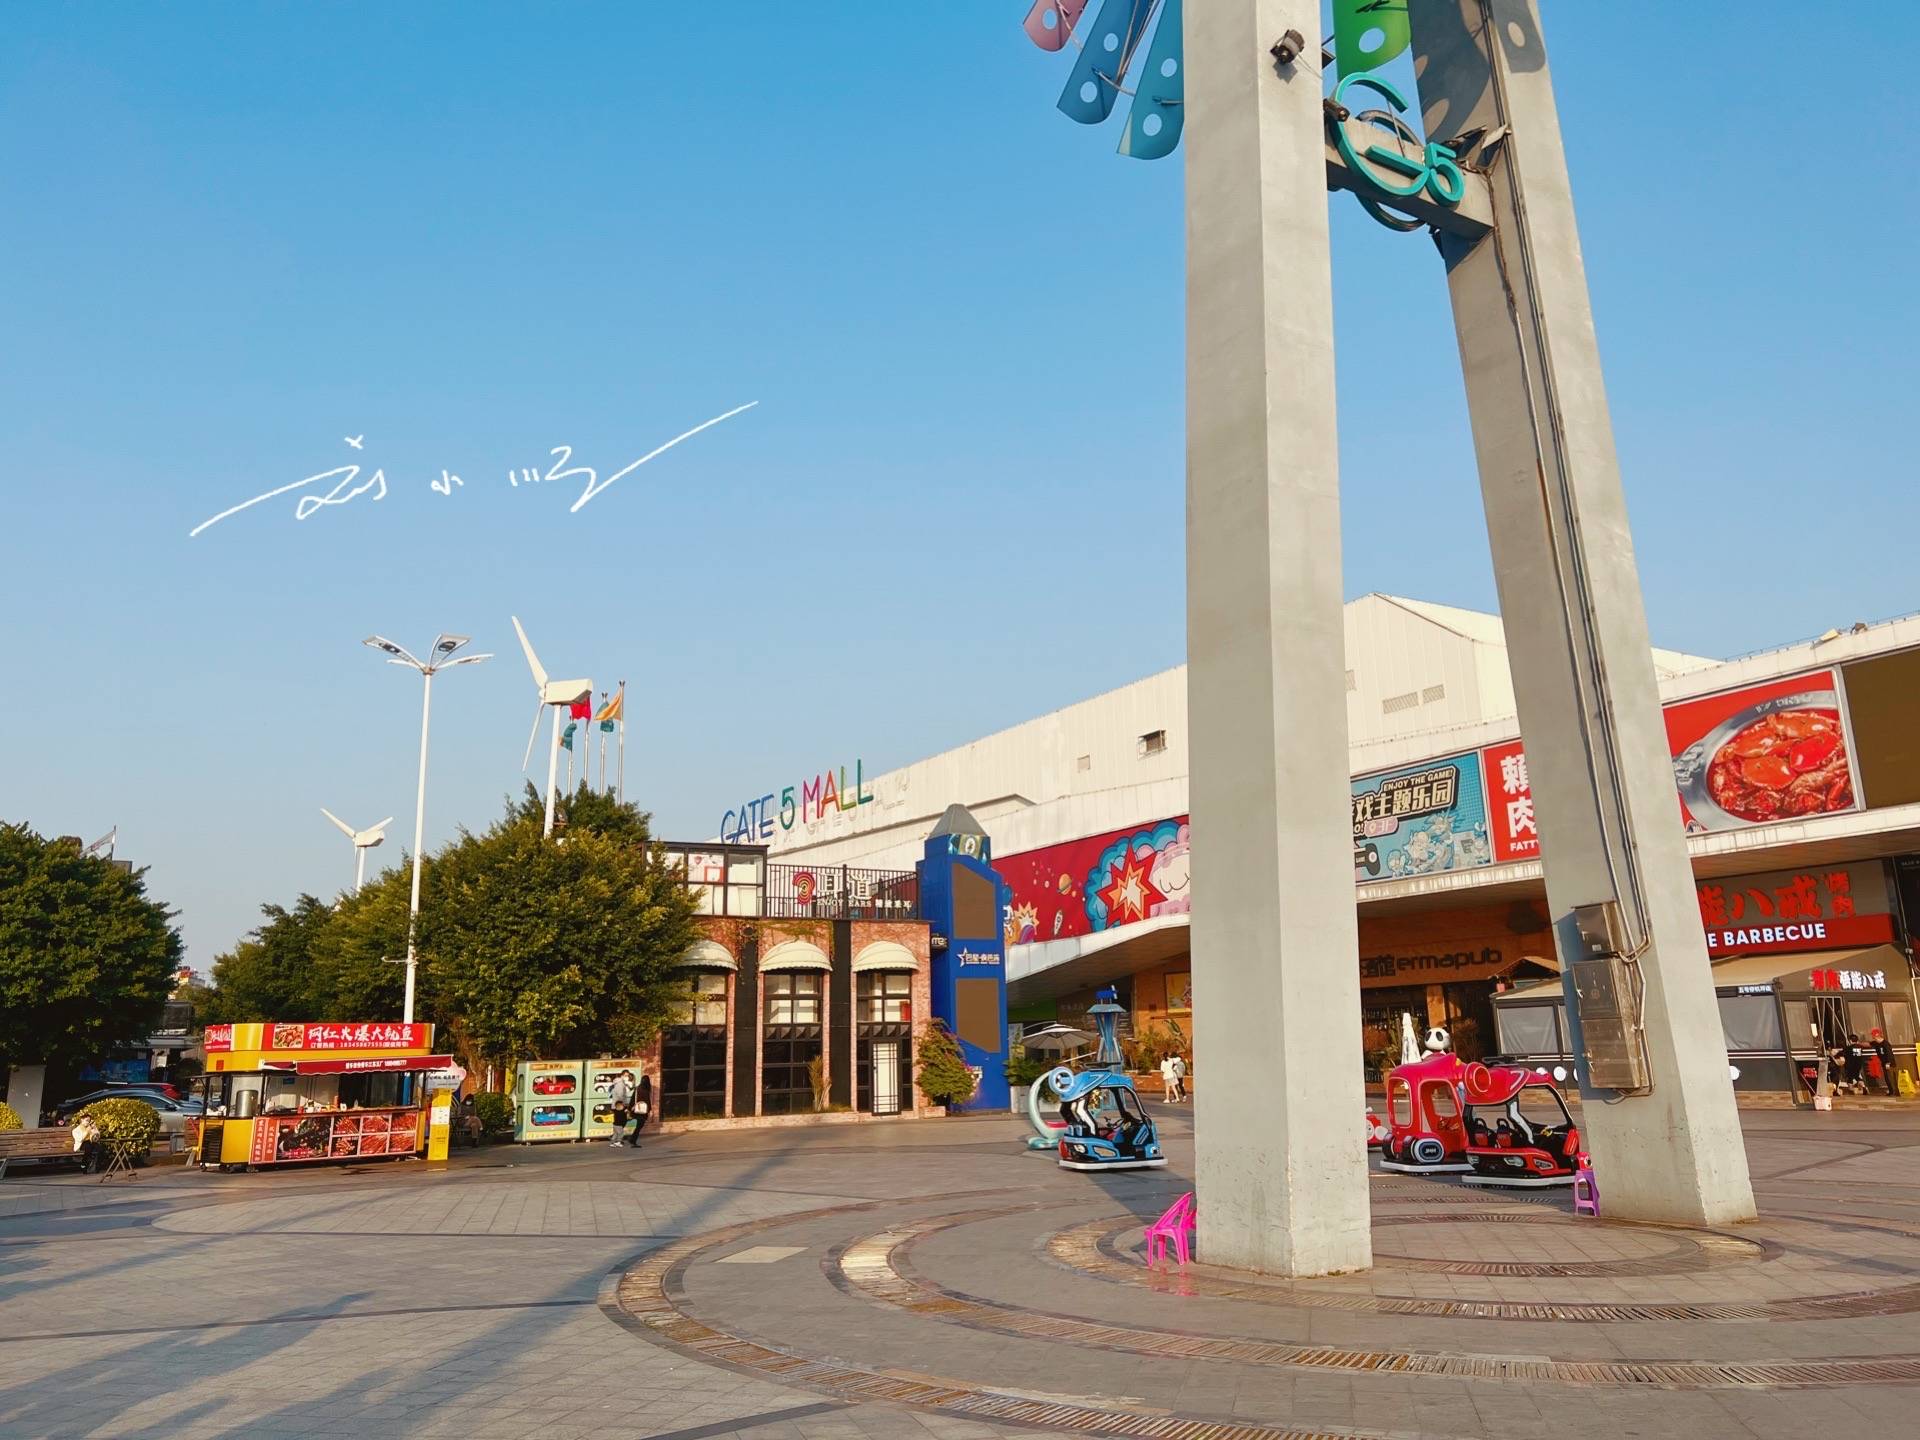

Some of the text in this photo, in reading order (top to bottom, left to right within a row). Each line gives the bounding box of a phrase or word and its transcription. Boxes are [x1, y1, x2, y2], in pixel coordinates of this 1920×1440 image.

[1383, 778, 1410, 792] ENJOY
[1410, 775, 1426, 785] THE
[720, 758, 875, 845] GATE 5 MALL
[1352, 779, 1453, 823] 戏主题乐园
[816, 897, 872, 908] ENJOY EARS
[1723, 922, 1827, 946] BARBECUE
